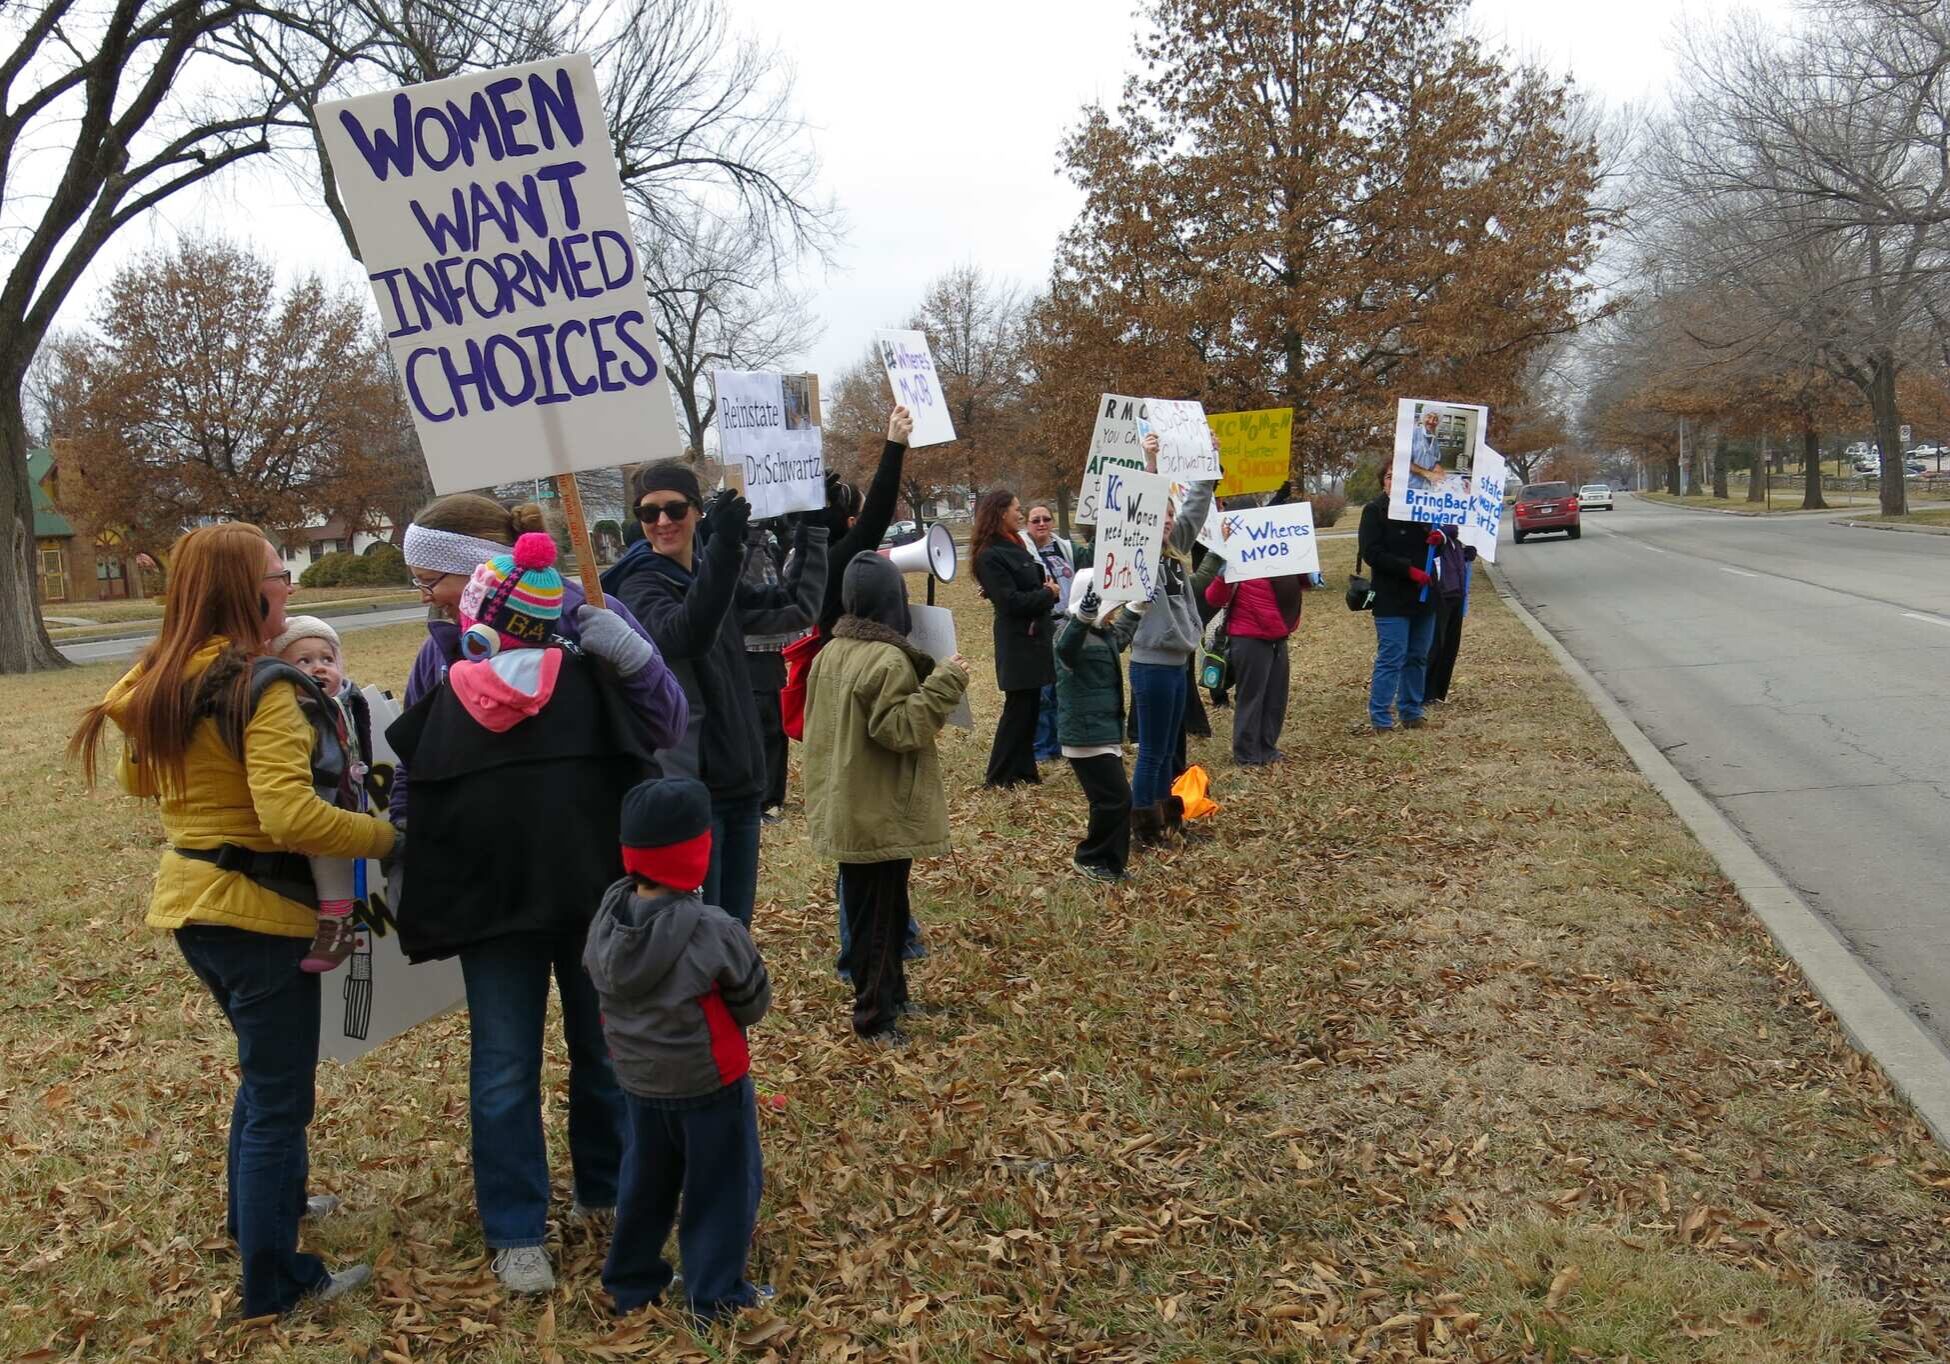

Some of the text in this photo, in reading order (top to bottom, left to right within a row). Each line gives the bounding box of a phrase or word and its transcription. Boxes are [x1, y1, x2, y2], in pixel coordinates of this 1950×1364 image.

[339, 68, 585, 181] WOMEN
[409, 161, 587, 256] WANT
[369, 230, 635, 338] INFORMED
[405, 310, 659, 422] CHOICES
[721, 396, 779, 430] Reinstate
[1215, 413, 1291, 441] KC WOMEN
[1103, 427, 1139, 445] YOU CA
[1105, 474, 1158, 527] KC Women
[1411, 505, 1467, 525] Howard
[1104, 519, 1149, 547] need better
[1241, 542, 1289, 563] MYOB
[1103, 552, 1133, 590] Birth
